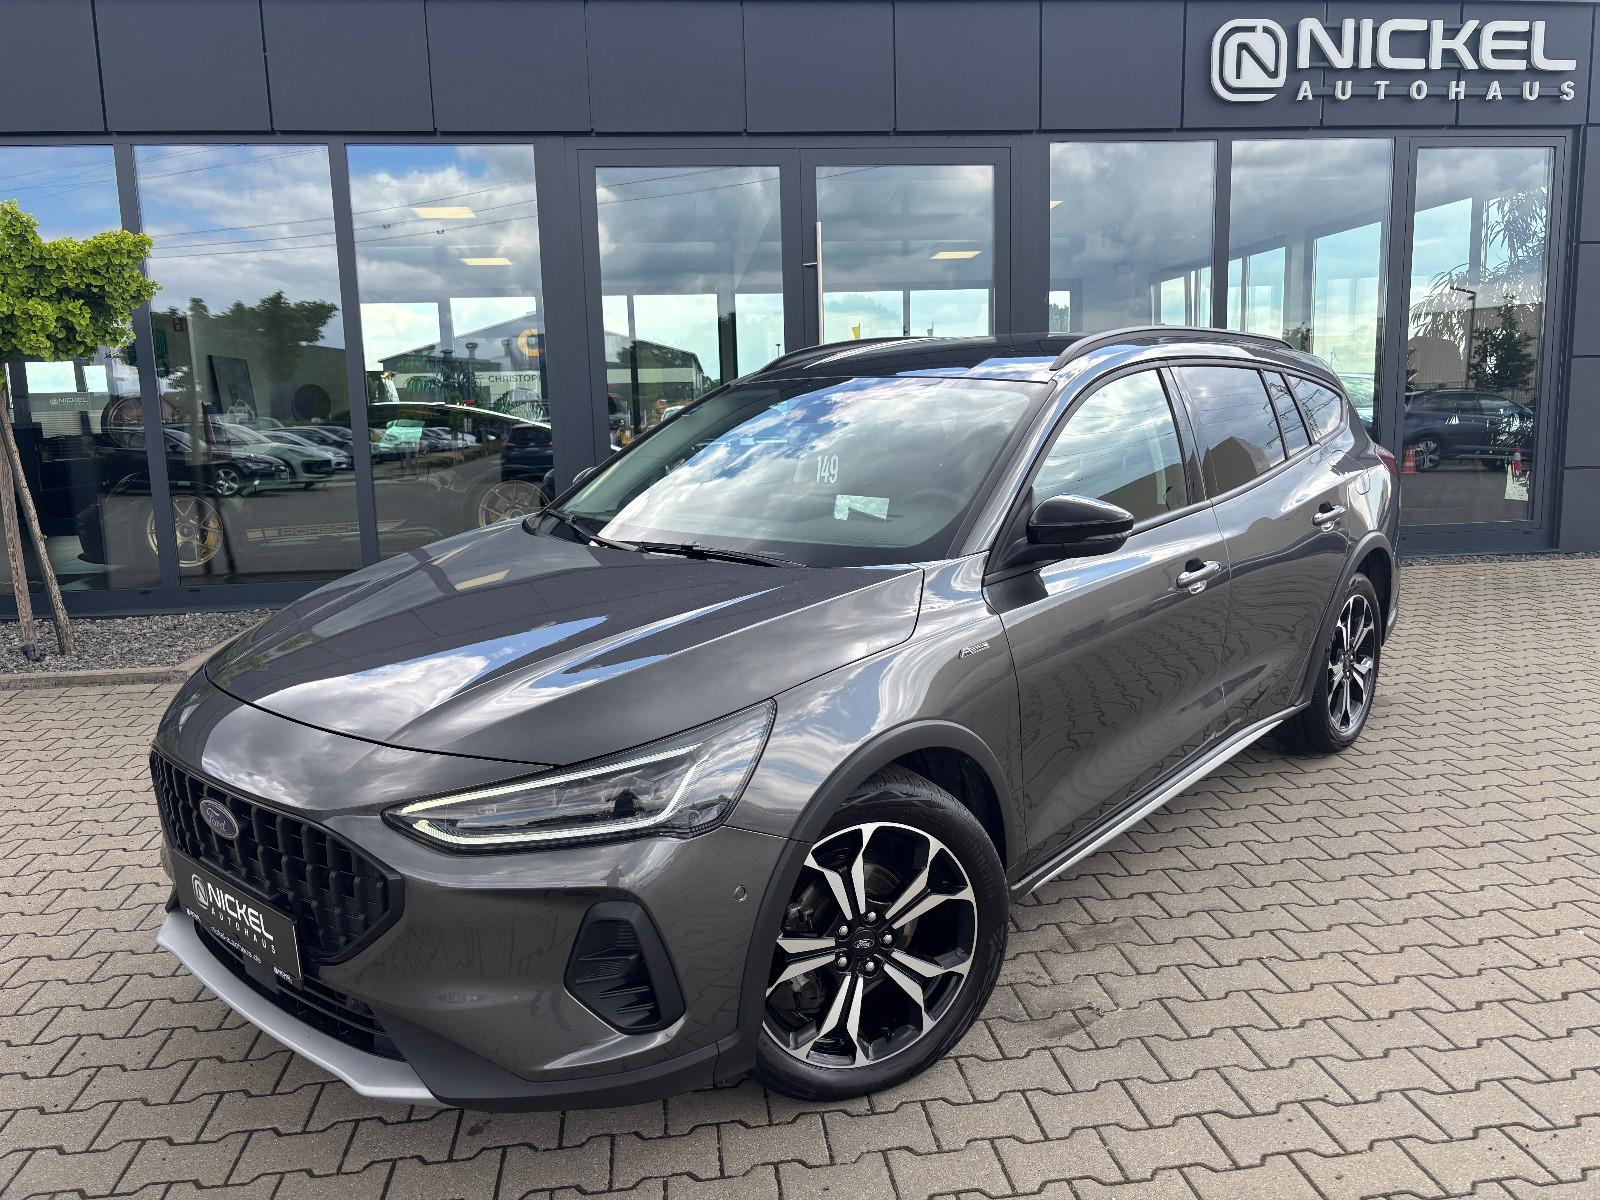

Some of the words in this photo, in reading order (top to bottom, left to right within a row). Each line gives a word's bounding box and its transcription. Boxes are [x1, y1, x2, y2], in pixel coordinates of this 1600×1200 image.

[1296, 17, 1577, 72] NICKEL
[1295, 80, 1575, 102] AUTOHAUS
[488, 374, 541, 383] CHRISTOP
[816, 454, 839, 484] 149
[281, 523, 360, 537] PORSCH
[206, 807, 228, 832] Ford
[207, 882, 274, 941] NICKEL
[211, 906, 277, 954] AUTOHAUS
